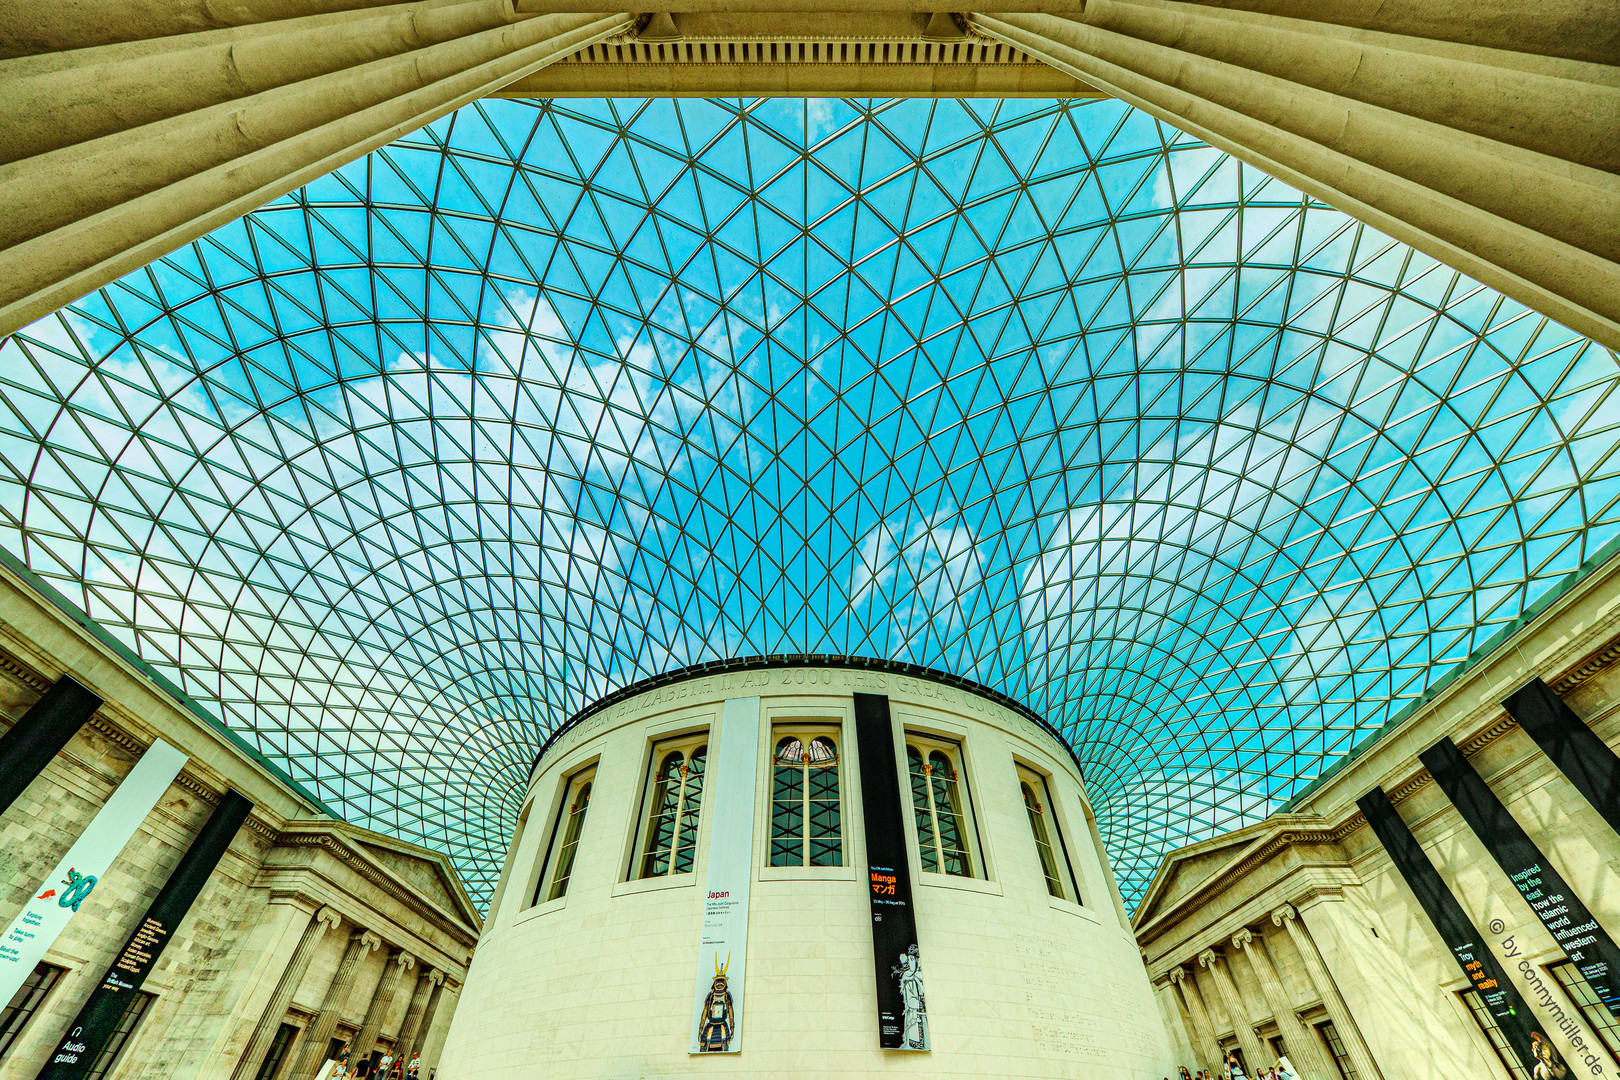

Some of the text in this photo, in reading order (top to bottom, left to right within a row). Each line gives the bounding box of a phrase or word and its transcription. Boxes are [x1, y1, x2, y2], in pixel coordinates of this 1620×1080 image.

[570, 706, 613, 743] QUEEN
[616, 676, 714, 719] ELIZABETH
[741, 671, 771, 688] AD
[781, 669, 832, 685] 2000
[840, 670, 887, 689] THIS
[896, 676, 956, 704] GREAT
[964, 692, 1014, 726] COURT
[871, 872, 897, 885] Manga
[1510, 864, 1541, 882] Inspired
[872, 884, 895, 896] マンガ
[1517, 877, 1542, 892] by the
[707, 890, 730, 900] Japan
[1525, 888, 1543, 901] east
[1531, 894, 1565, 911] how the
[27, 911, 43, 921] Explore
[1538, 904, 1569, 920] Islamic
[1546, 915, 1571, 930] world
[14, 927, 35, 939] Take turns
[1553, 919, 1599, 941] influenced
[1562, 934, 1598, 951] western
[1458, 952, 1474, 962] Troy
[1570, 950, 1585, 962] art
[1465, 960, 1482, 971] myth
[1471, 969, 1486, 981] and
[106, 977, 134, 989] British Museum
[1477, 978, 1498, 990] reality
[62, 1040, 86, 1053] Audio
[54, 1053, 78, 1064] guide
